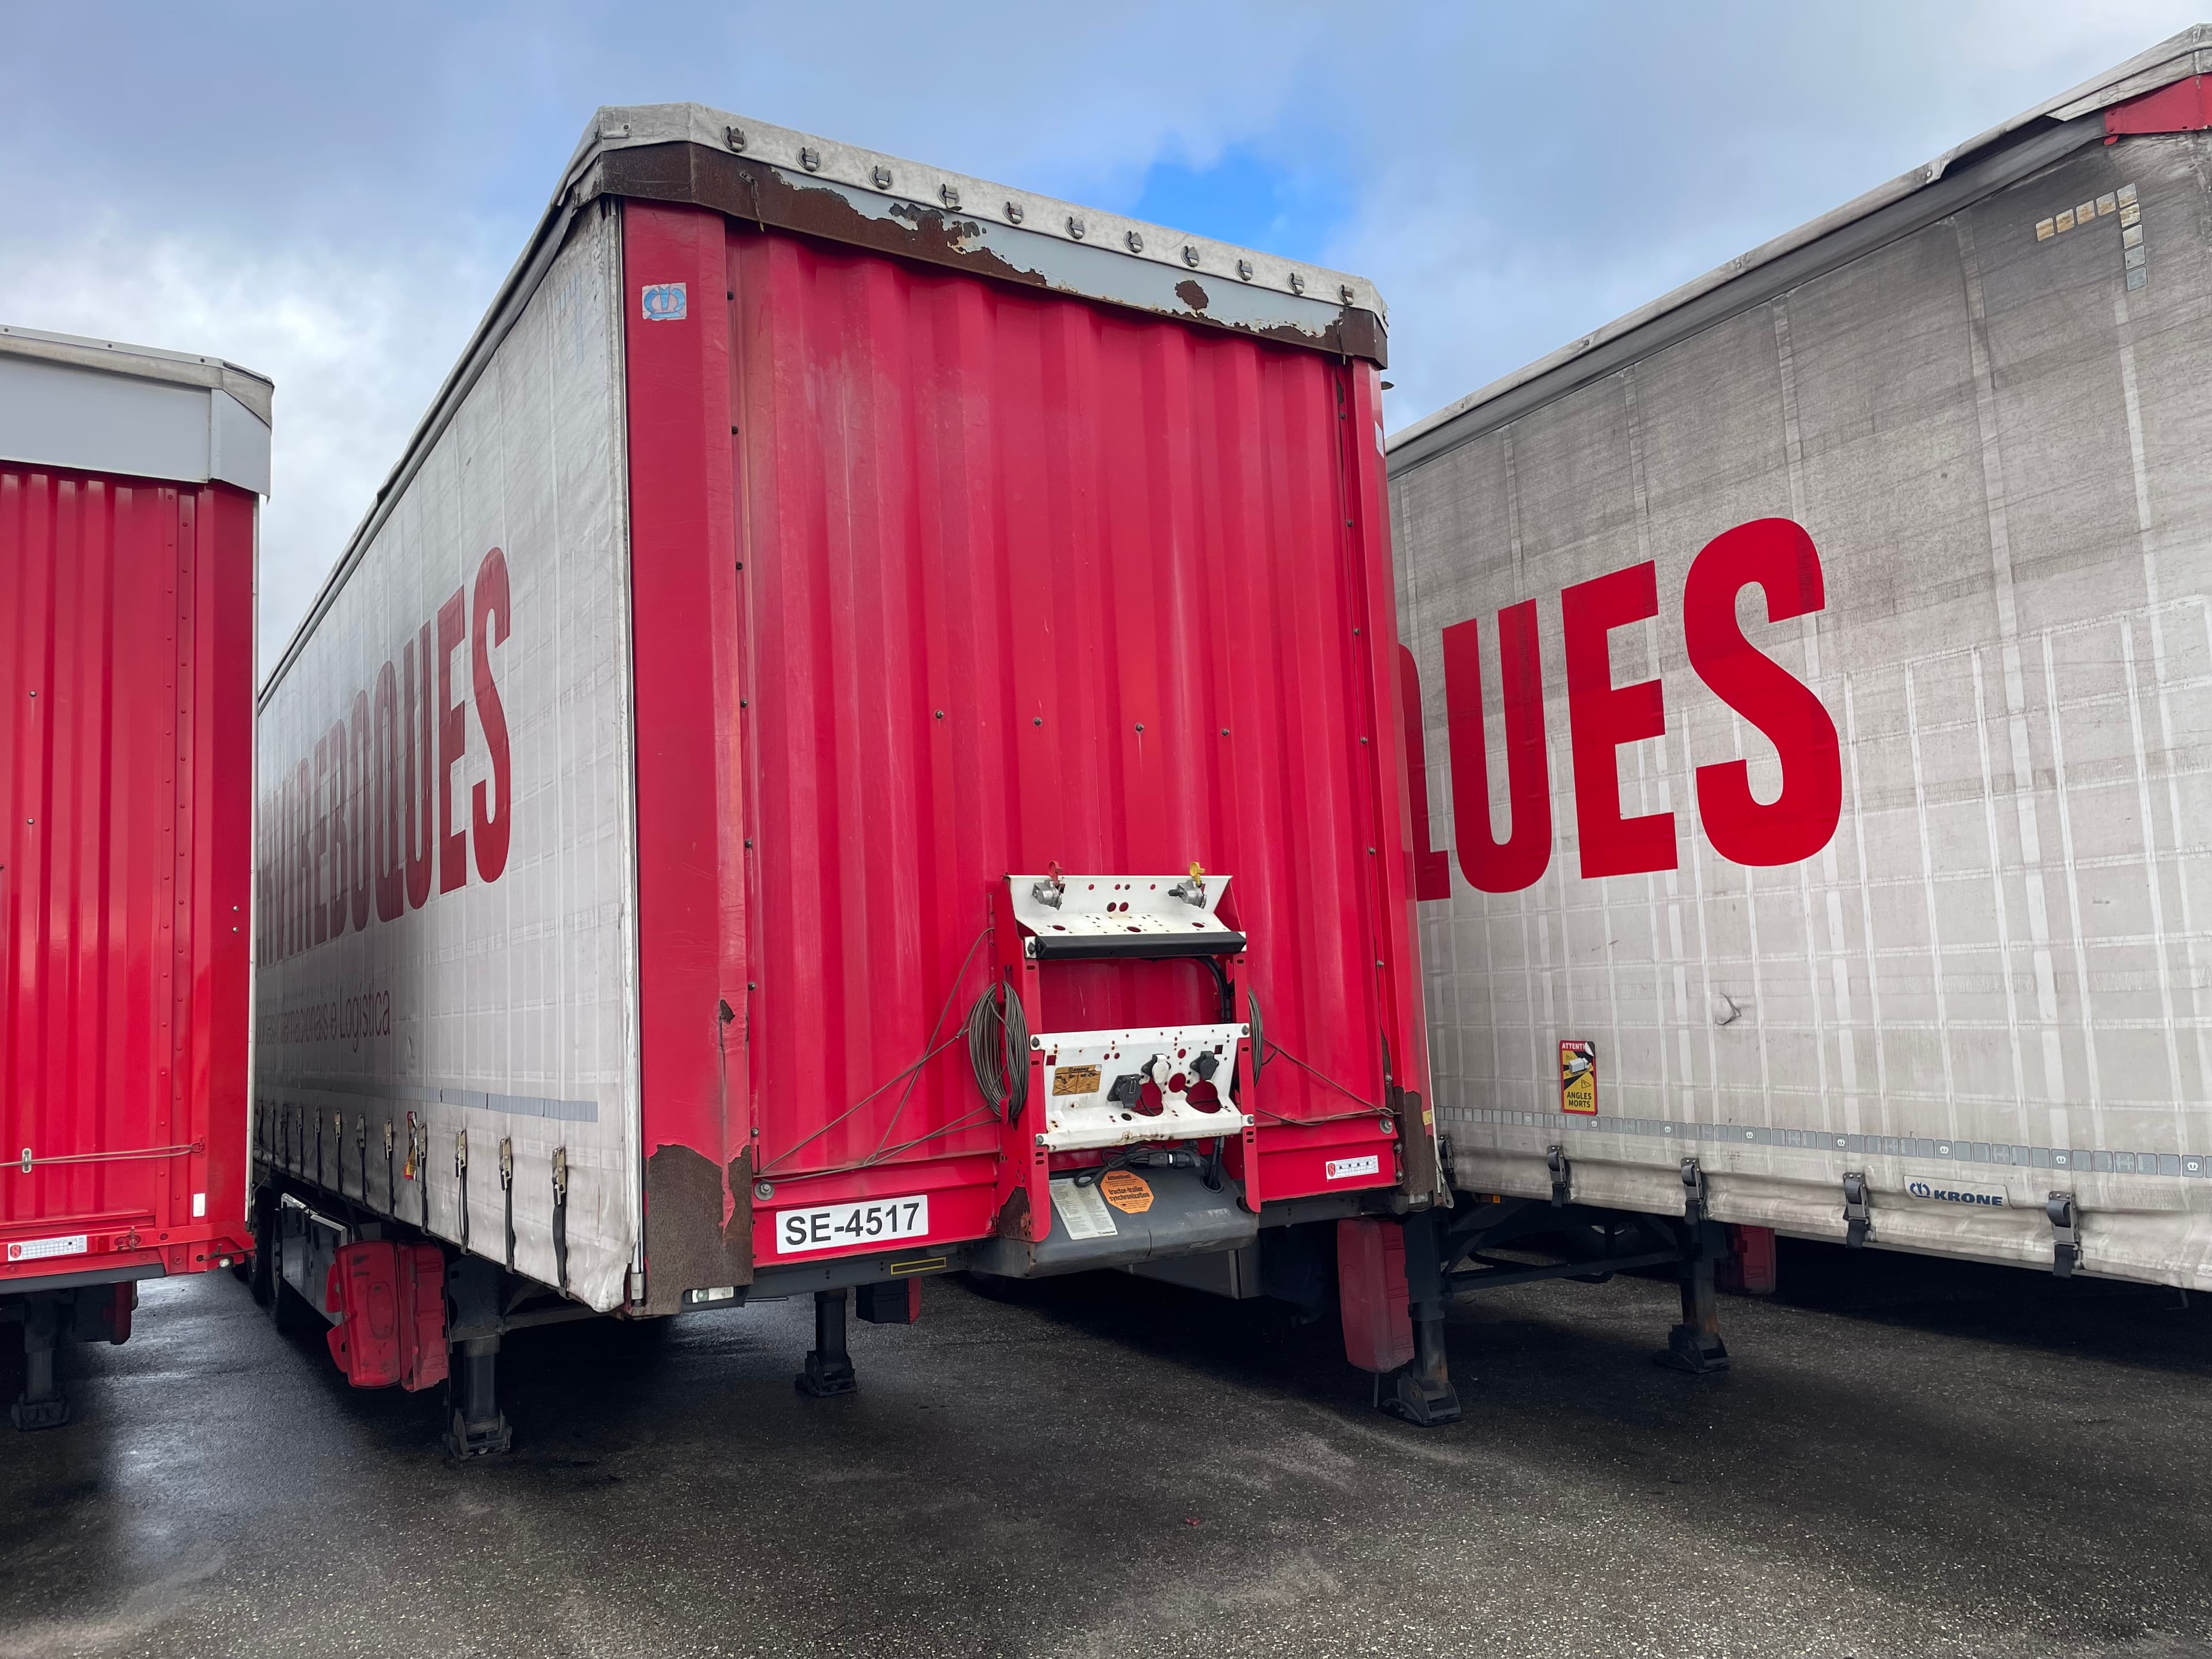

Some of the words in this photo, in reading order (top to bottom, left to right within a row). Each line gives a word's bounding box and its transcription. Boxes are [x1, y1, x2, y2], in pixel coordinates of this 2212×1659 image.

[340, 979, 391, 1054] Logística
[1567, 1091, 1592, 1100] ANGLES
[1569, 1099, 1590, 1108] MORTS
[1108, 1186, 1143, 1195] tractor-trailer
[1109, 1192, 1150, 1202] synchronization
[1934, 1190, 2003, 1206] KRONE
[785, 1202, 920, 1245] SE-4517
